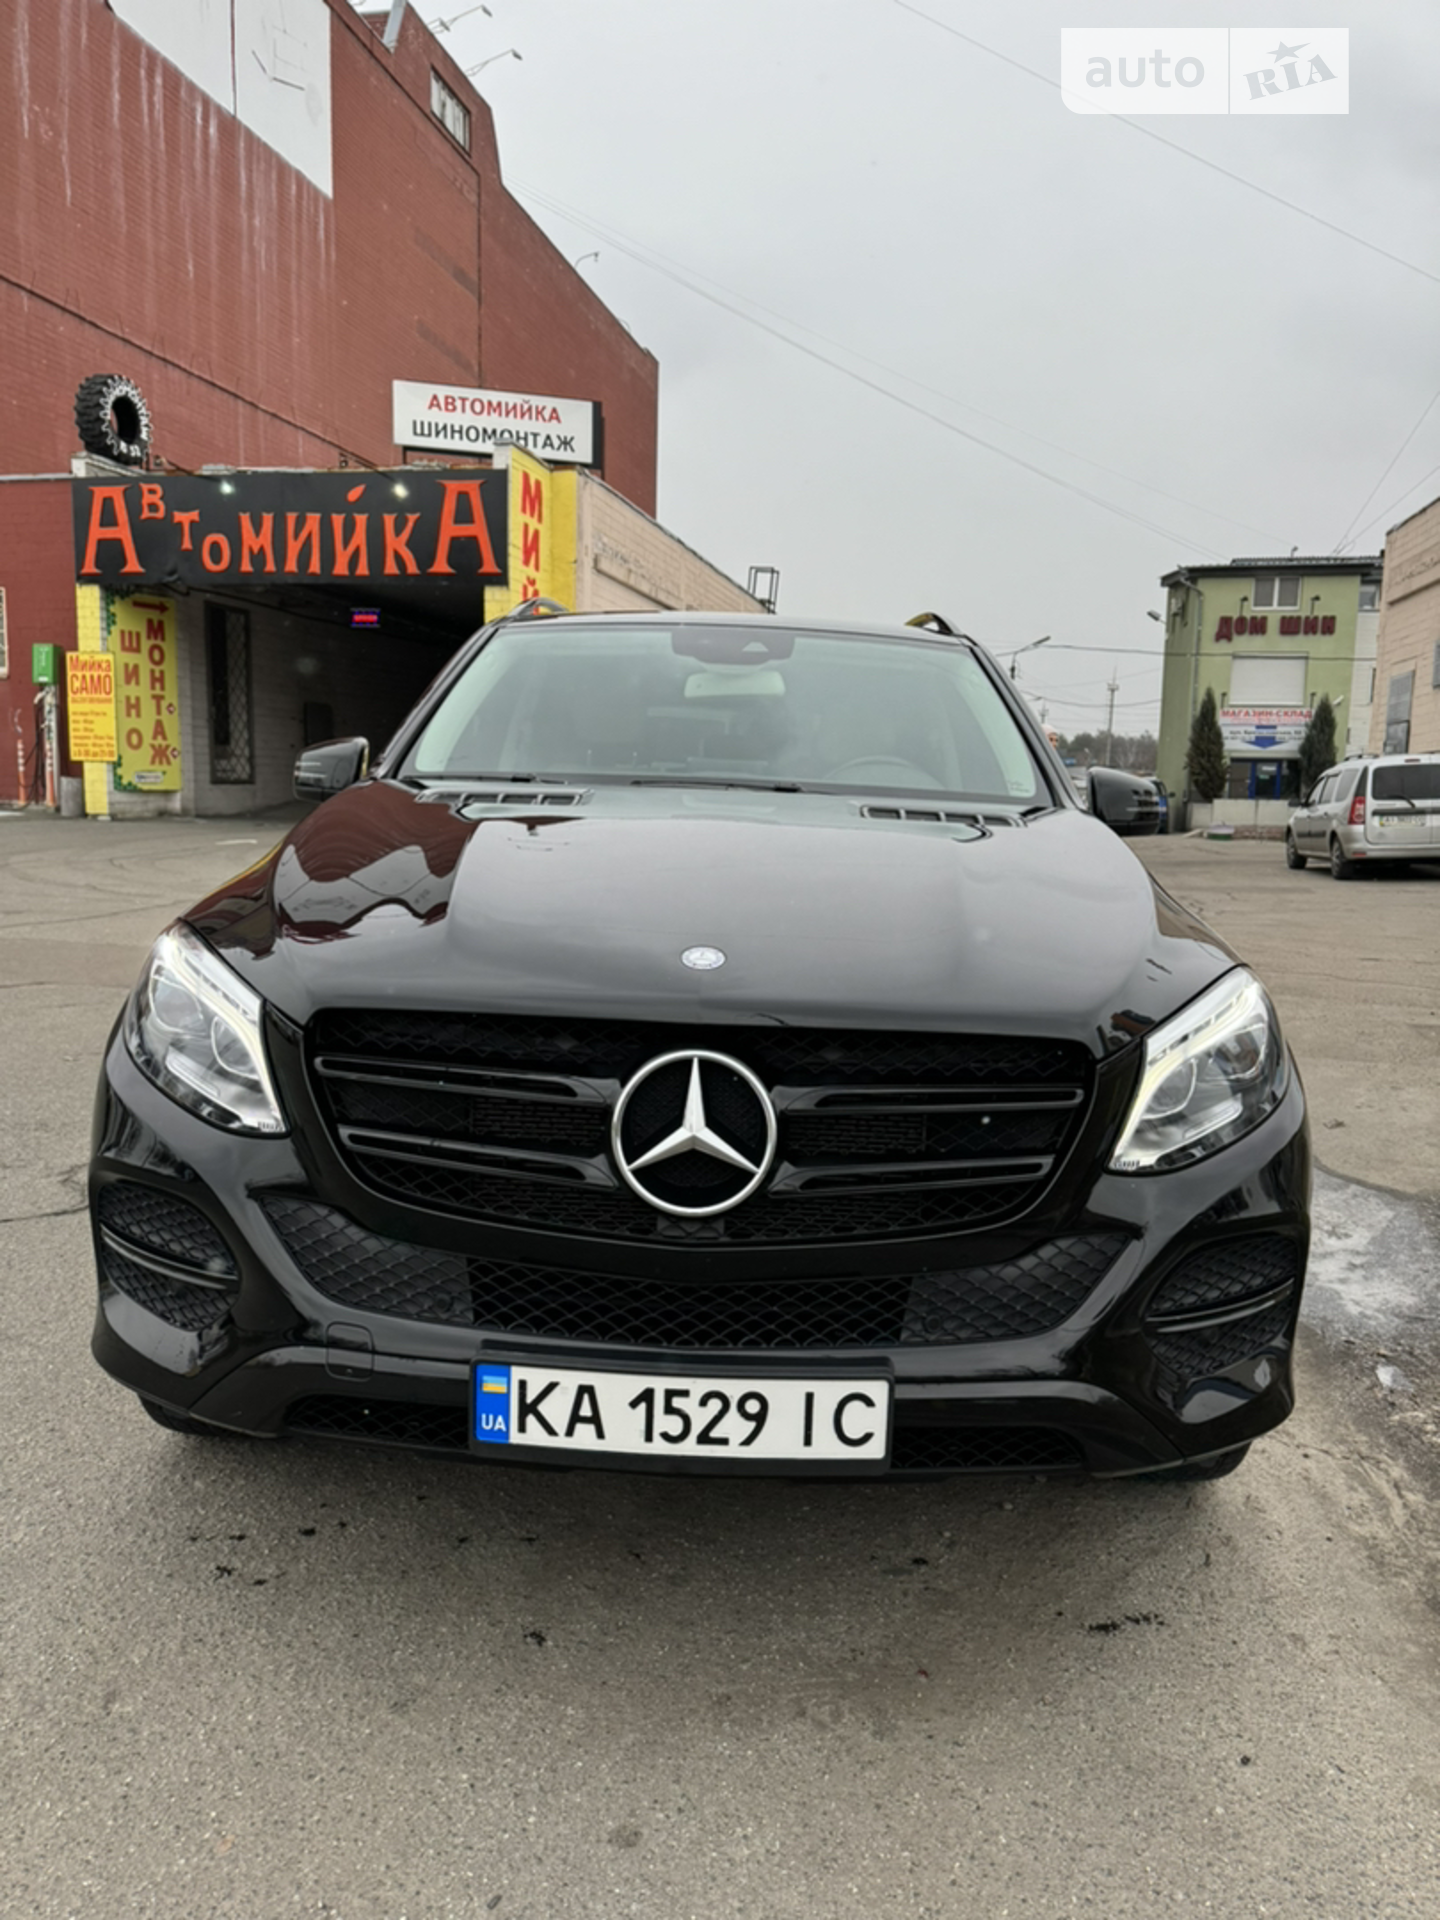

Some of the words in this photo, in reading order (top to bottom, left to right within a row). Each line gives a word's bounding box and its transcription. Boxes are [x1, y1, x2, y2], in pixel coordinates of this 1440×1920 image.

[428, 394, 562, 424] АВТОМИЙКА
[412, 419, 576, 453] ШИНОМОНТАЖ
[1214, 615, 1268, 642] ДОМ
[1279, 615, 1336, 636] ШИН
[69, 655, 112, 673] Мийка
[70, 674, 112, 696] САМО
[120, 629, 143, 751] ШИНО
[146, 618, 171, 766] МОНТАЖ
[1221, 710, 1313, 719] МАГАЗИН-СКЛАД
[481, 1414, 506, 1432] UA
[517, 1379, 605, 1440] KA
[628, 1387, 769, 1447] 1529
[803, 1391, 876, 1447] IC
